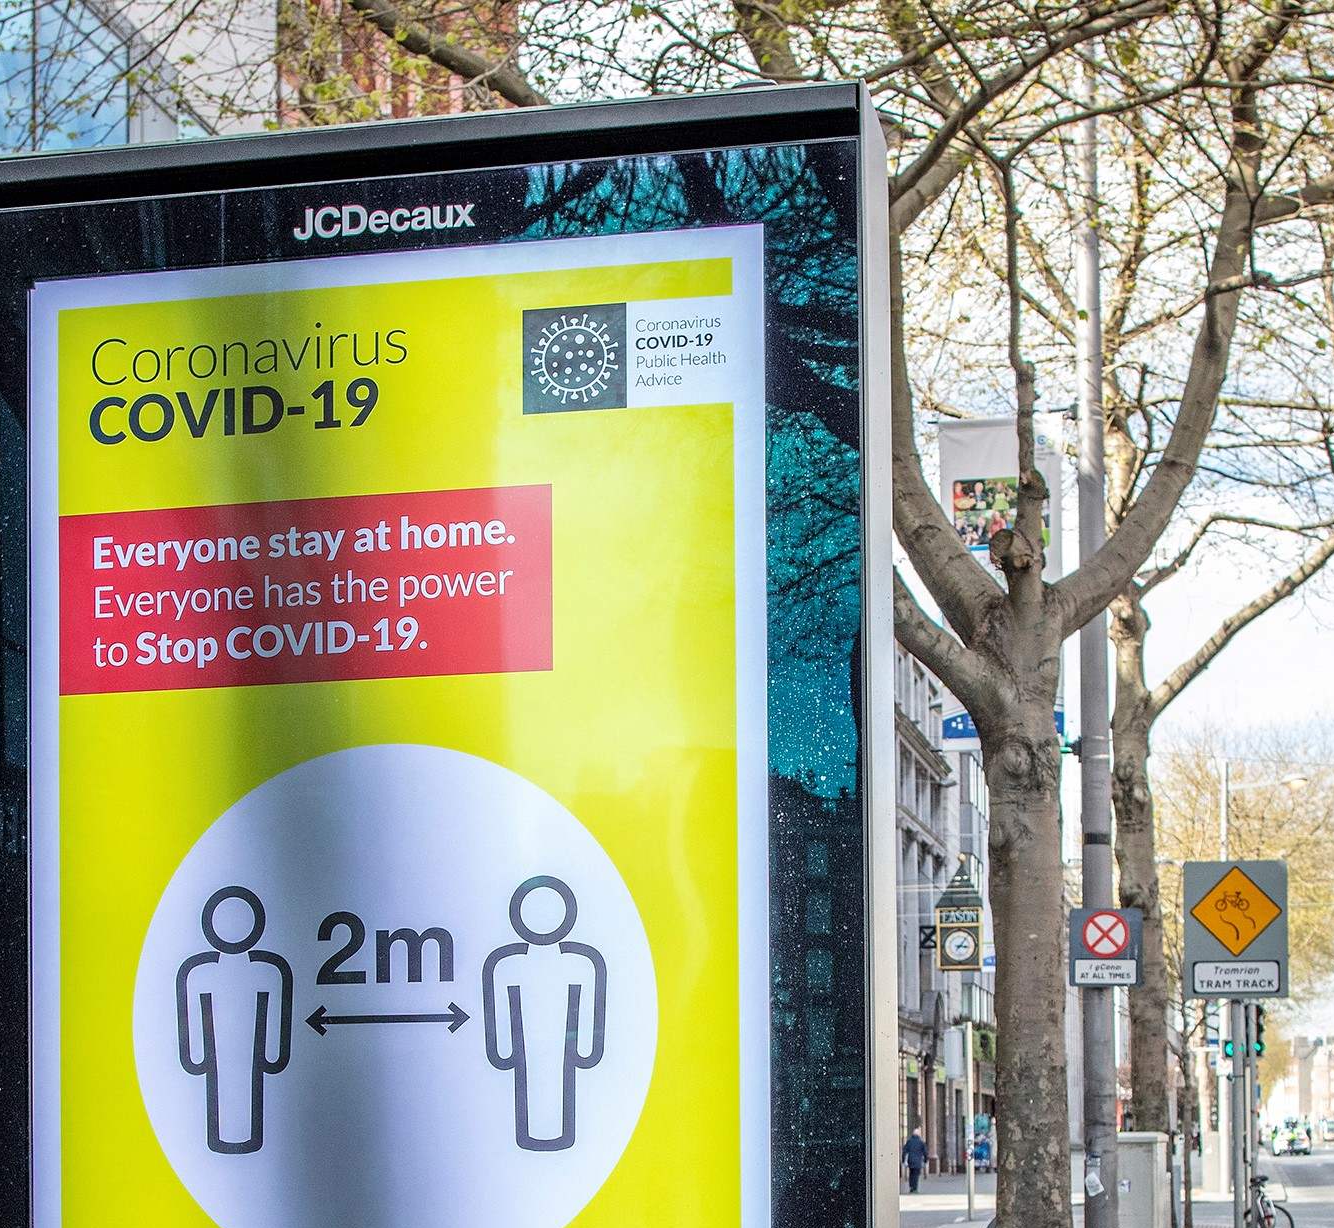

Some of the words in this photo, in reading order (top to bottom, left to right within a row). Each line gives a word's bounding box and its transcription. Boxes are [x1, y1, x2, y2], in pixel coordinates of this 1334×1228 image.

[293, 203, 476, 241] JCDecaux
[635, 315, 722, 333] Coronavirus
[635, 333, 714, 350] COVID-19
[91, 322, 408, 386] Coronavirus
[636, 354, 677, 369] Public
[680, 351, 726, 366] Health
[635, 373, 683, 387] Advice
[89, 377, 380, 445] COVID-19
[92, 535, 260, 571] Everyone
[267, 526, 345, 561] stay
[354, 520, 391, 552] at
[400, 516, 516, 551] home.
[94, 584, 254, 621] Everyone
[264, 574, 322, 608] has
[330, 570, 389, 604] the
[399, 568, 514, 607] power
[93, 637, 128, 668] to
[135, 631, 219, 668] Stop
[226, 615, 429, 660] COVID-19.
[315, 911, 455, 985] 2m
[1199, 980, 1232, 988] TRAM
[1236, 979, 1275, 988] TRACK
